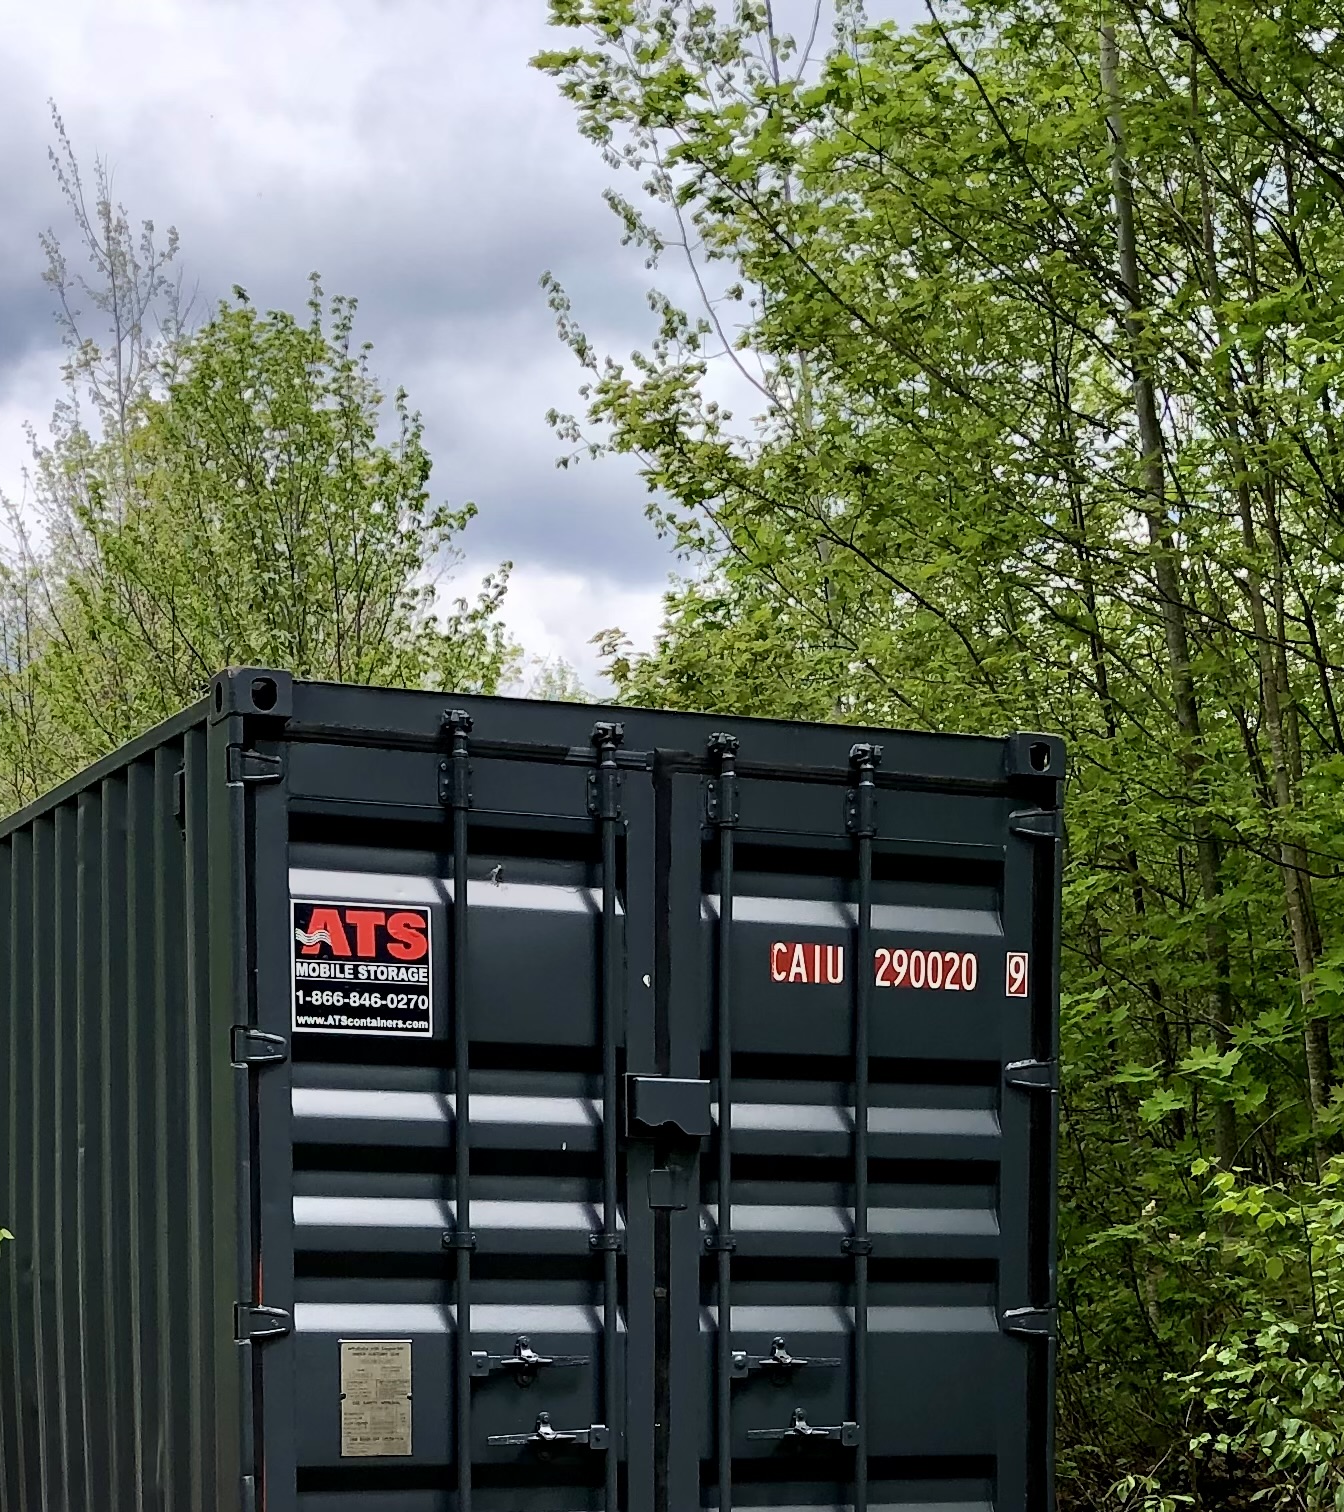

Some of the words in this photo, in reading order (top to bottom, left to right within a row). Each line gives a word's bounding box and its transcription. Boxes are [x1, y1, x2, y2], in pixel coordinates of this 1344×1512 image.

[301, 908, 428, 960] ATS
[295, 963, 354, 978] MOBILE
[357, 966, 428, 981] STORAGE
[772, 942, 844, 983] CAIU
[874, 948, 977, 991] 290020
[1009, 956, 1026, 993] 9
[295, 990, 428, 1009] 1-866-846-0270
[296, 1015, 428, 1029] www.ATScontainers.com
